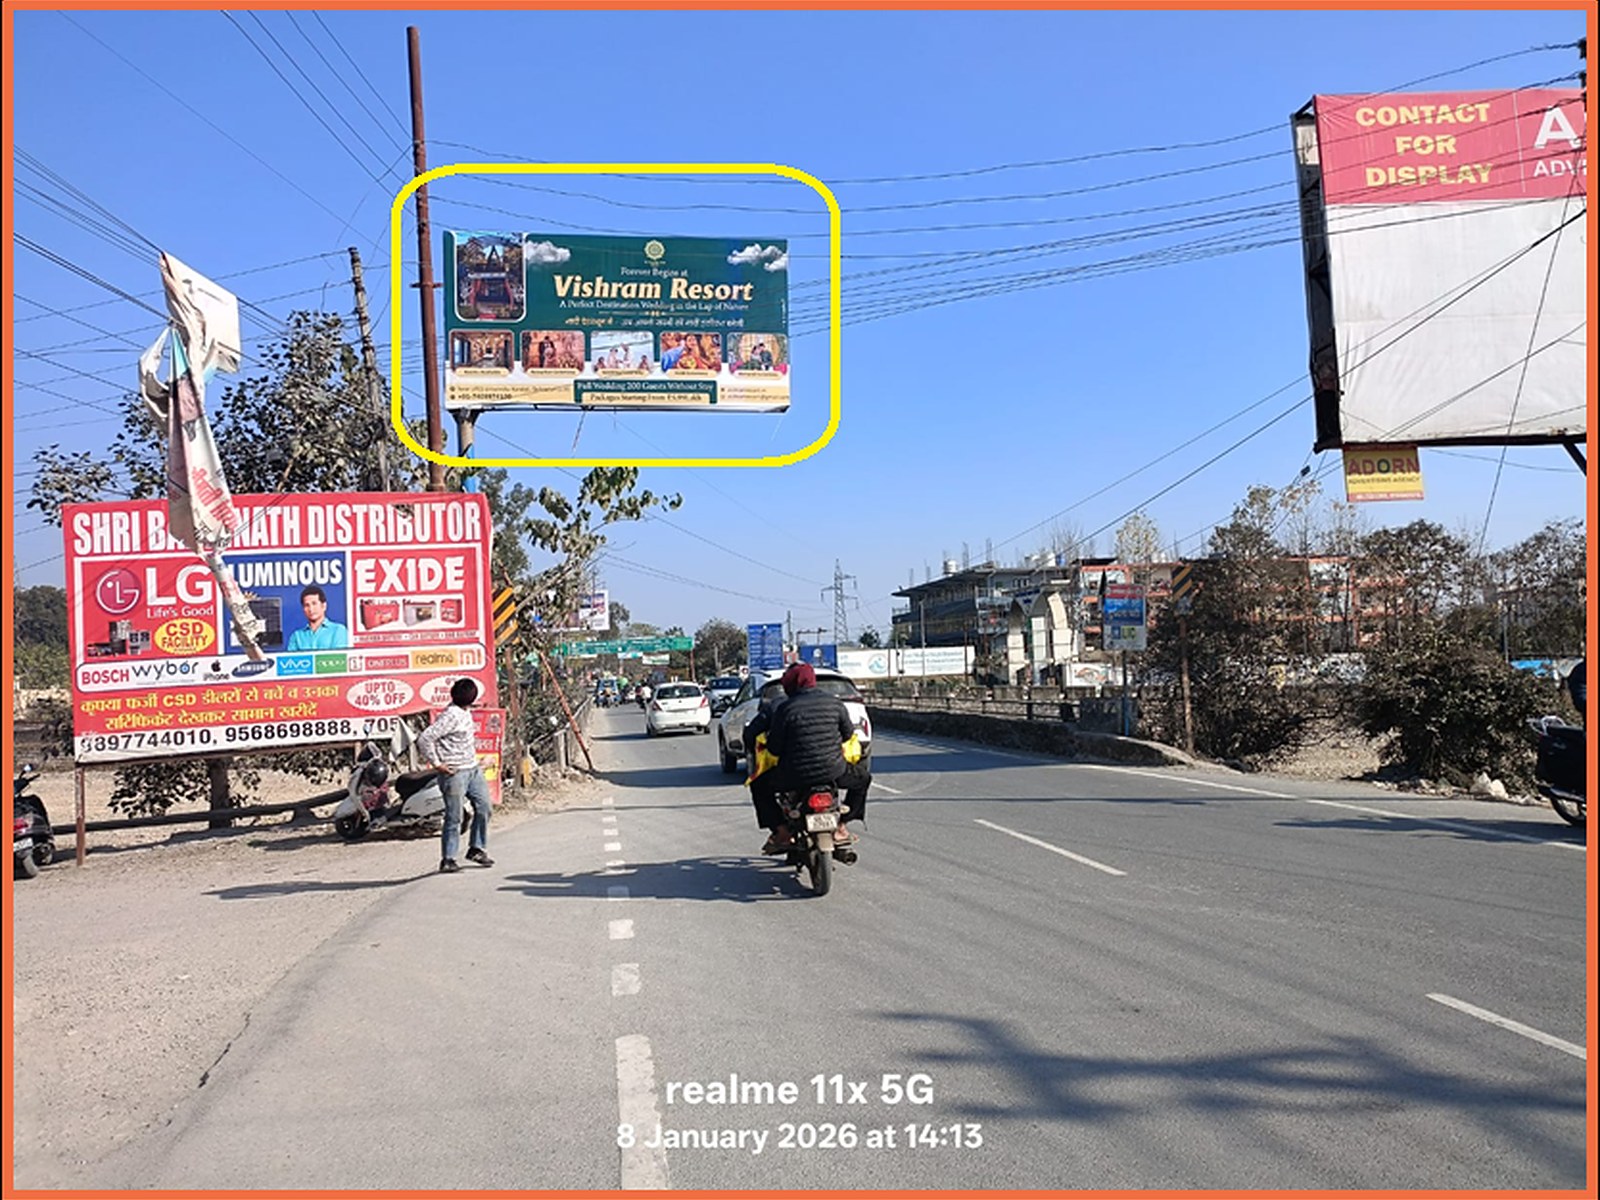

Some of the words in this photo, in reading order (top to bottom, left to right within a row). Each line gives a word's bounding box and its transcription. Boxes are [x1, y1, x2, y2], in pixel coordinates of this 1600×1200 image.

[1355, 103, 1491, 127] CONTACT
[1533, 106, 1587, 150] A
[1395, 134, 1457, 156] FOR
[1365, 163, 1493, 187] DISPLAY
[553, 275, 661, 300] Vishram
[670, 278, 754, 301] Resort
[559, 300, 567, 309] A
[567, 300, 595, 309] Perfect
[627, 382, 641, 390] 200
[1347, 458, 1420, 475] ADORN
[73, 511, 140, 555] SHRI
[308, 501, 481, 546] DISTRIBUTOR
[146, 565, 212, 606] LG
[354, 556, 465, 594] EXIDE
[147, 606, 179, 619] Life's
[181, 605, 214, 618] Good
[166, 621, 204, 636] CSD
[161, 635, 208, 648] FACILITY
[81, 669, 130, 685] BOSCH
[203, 672, 230, 682] iPhone
[279, 658, 311, 669] vivo
[368, 656, 407, 668] ONEPLUS
[416, 652, 454, 666] realme
[354, 693, 381, 706] 40%
[384, 692, 406, 705] OFF
[364, 681, 396, 694] UPTO
[81, 699, 121, 716] कृपया
[126, 694, 158, 711] फर्जी
[162, 694, 196, 707] CSD
[246, 687, 259, 701] से
[288, 688, 299, 699] व
[303, 684, 339, 699] उनका
[179, 708, 226, 725] देखकर
[231, 706, 274, 721] सामान
[225, 719, 358, 743] 9568698888,
